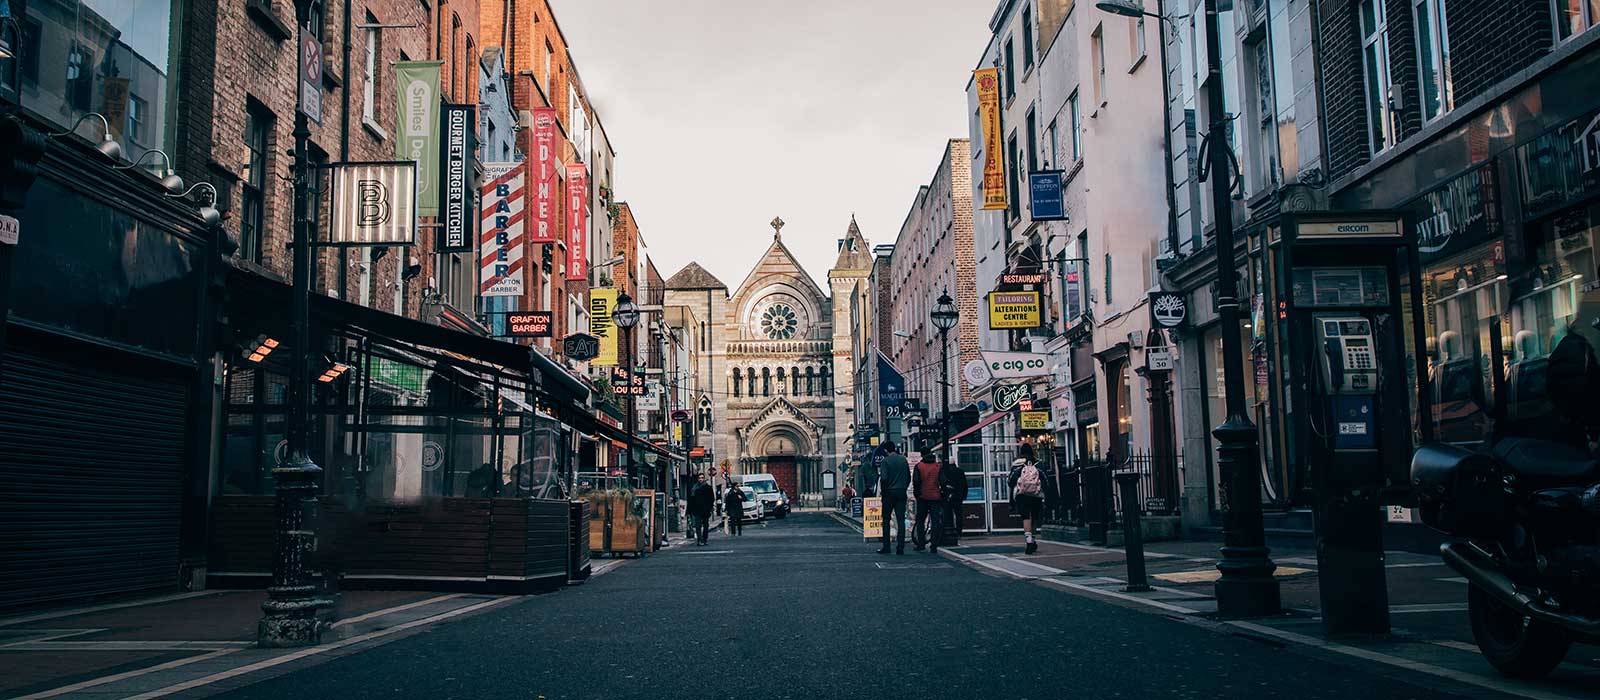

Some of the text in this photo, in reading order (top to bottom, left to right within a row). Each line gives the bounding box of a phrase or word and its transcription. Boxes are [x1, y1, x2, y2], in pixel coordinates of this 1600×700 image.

[413, 88, 425, 131] Smiles
[449, 110, 464, 247] GOURMET BURGER KITCHEN
[538, 145, 552, 238] DINER
[357, 180, 391, 227] B
[495, 184, 511, 278] BARBER
[572, 195, 582, 275] DINER
[1003, 275, 1041, 284] RESTAURANT
[998, 295, 1033, 303] TAILORING
[995, 305, 1037, 313] ALTERATIONS
[510, 315, 550, 323] GRAFTON
[1003, 313, 1028, 321] CENTRE
[512, 324, 547, 332] BARBER
[565, 339, 597, 357] EAT
[992, 362, 1000, 371] e
[1026, 358, 1045, 369] co
[887, 406, 901, 418] 22
